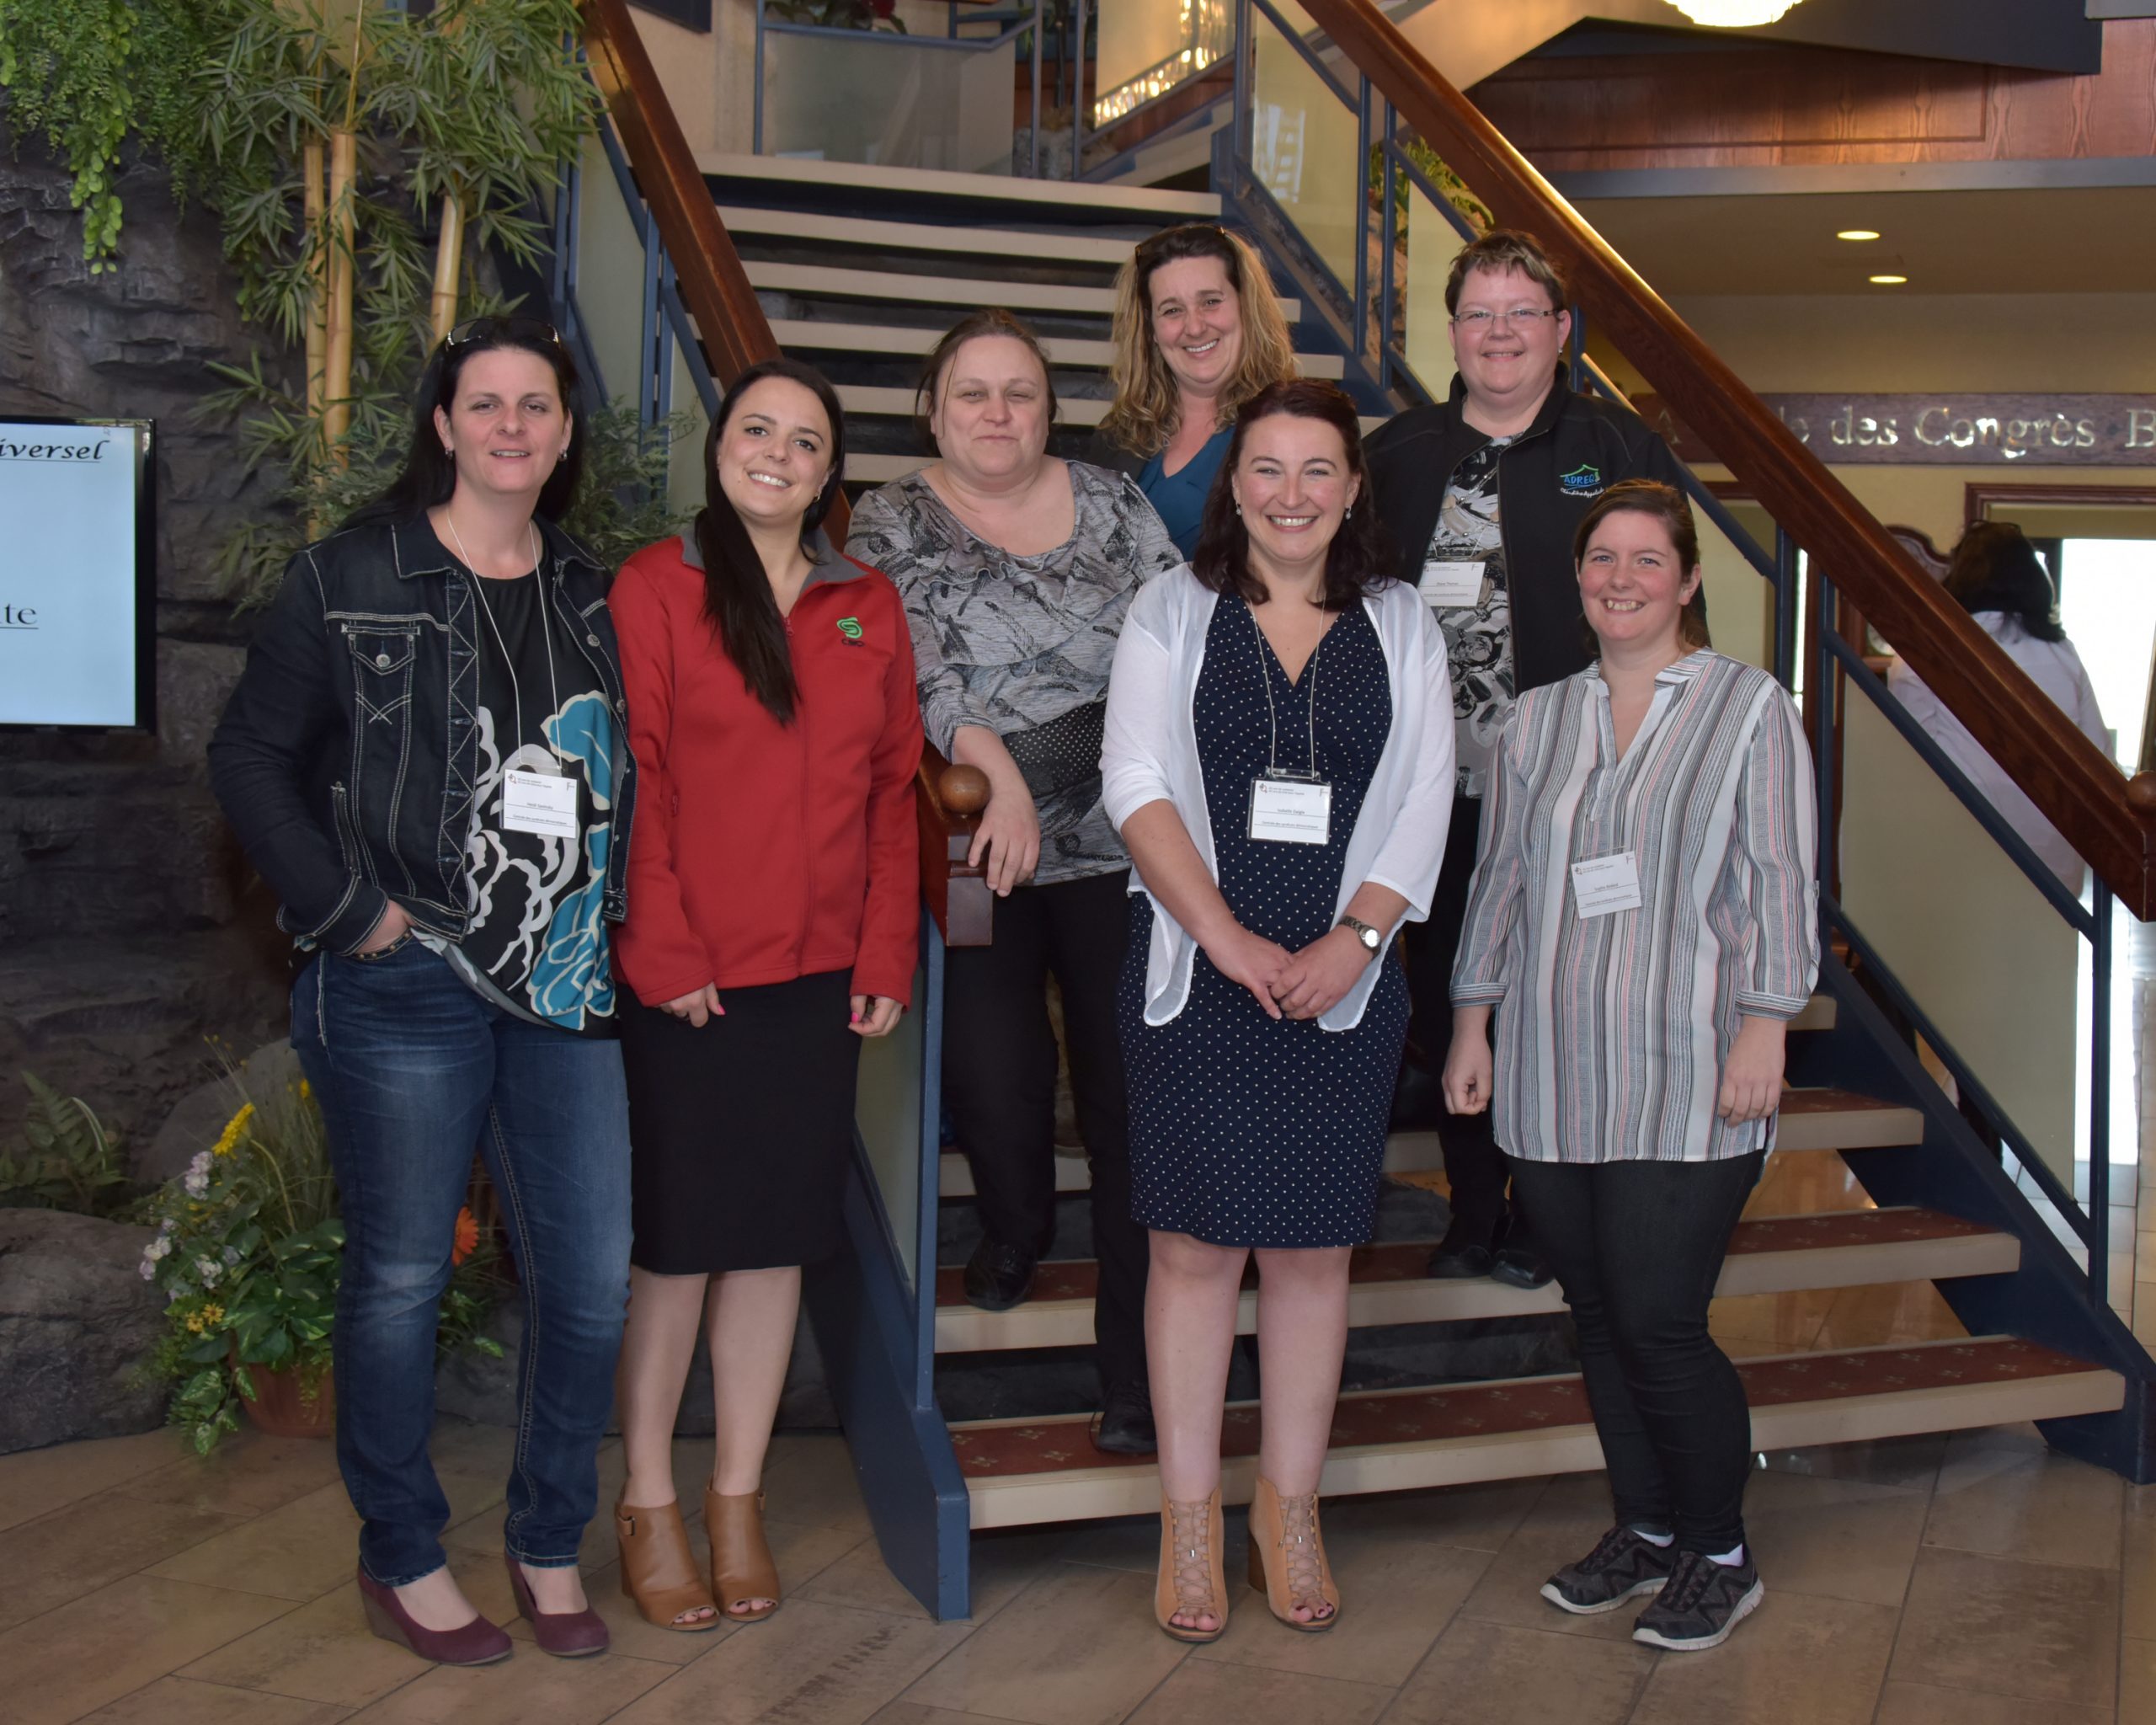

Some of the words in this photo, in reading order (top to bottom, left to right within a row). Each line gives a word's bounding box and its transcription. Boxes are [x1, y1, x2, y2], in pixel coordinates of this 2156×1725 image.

[1830, 404, 1899, 446] des
[1913, 406, 2096, 459] Congrès
[2124, 409, 2156, 448] B
[0, 603, 38, 625] te
